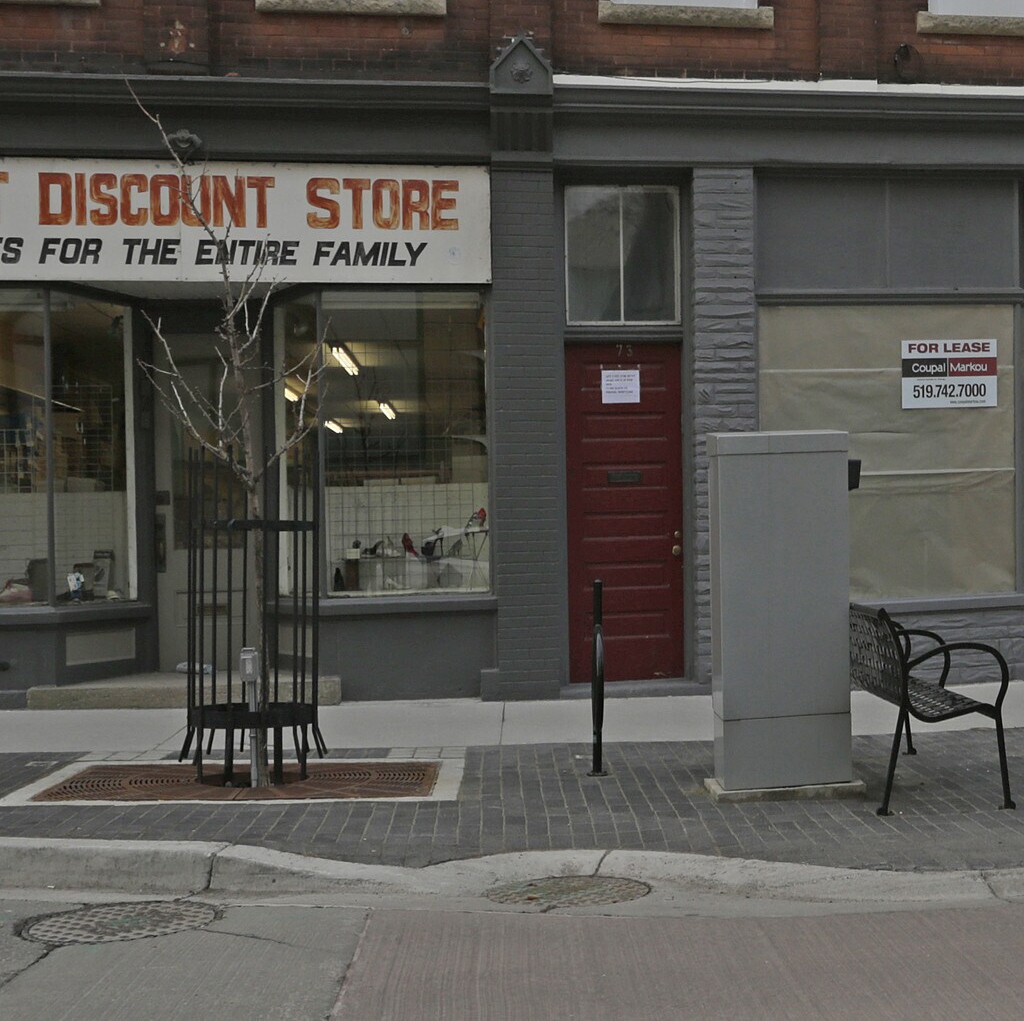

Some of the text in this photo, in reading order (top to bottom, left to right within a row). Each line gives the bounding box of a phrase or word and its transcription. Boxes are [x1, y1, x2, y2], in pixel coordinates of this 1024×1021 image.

[38, 172, 459, 230] DISCOUNT STORE
[38, 237, 103, 265] FOR
[122, 238, 181, 265] THE
[194, 239, 300, 266] ENTIRE
[312, 240, 428, 267] FAMILY
[616, 344, 633, 357] 73
[908, 342, 991, 353] FOR LEASE
[911, 363, 946, 375] Coupal
[949, 362, 988, 373] Markou
[913, 383, 987, 399] 519.742.7000
